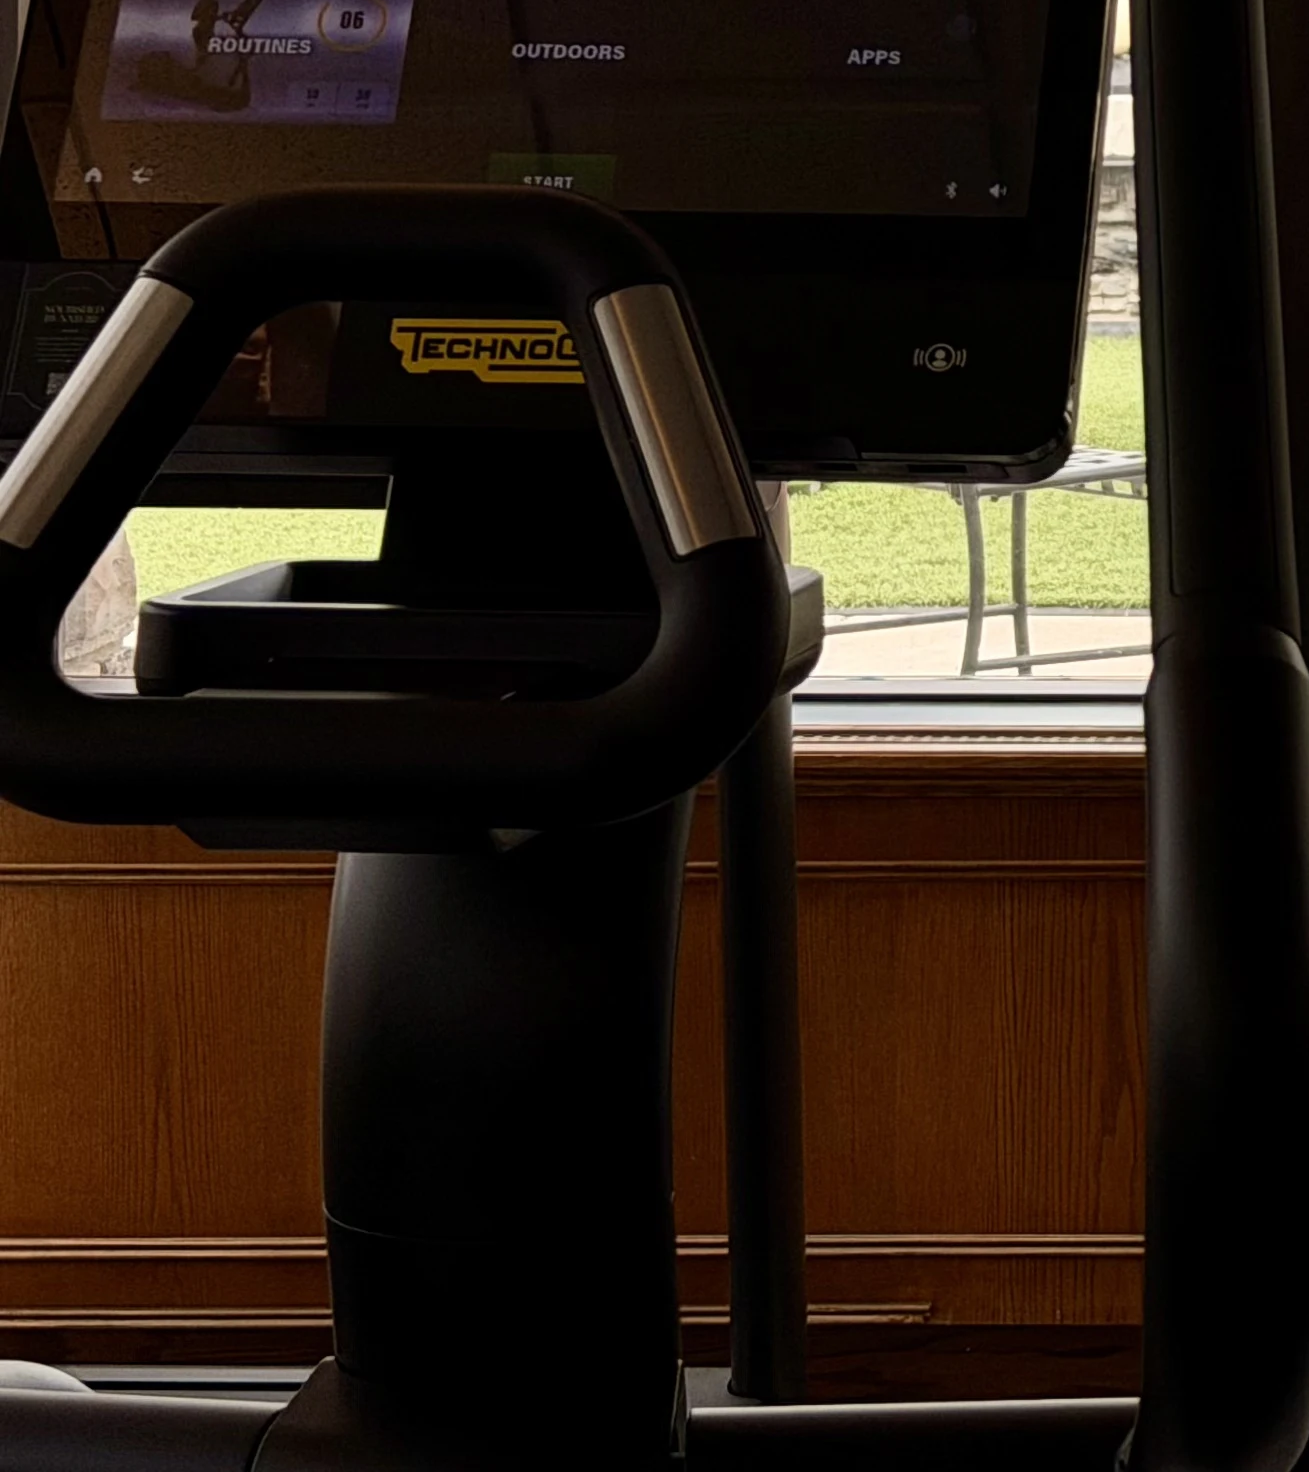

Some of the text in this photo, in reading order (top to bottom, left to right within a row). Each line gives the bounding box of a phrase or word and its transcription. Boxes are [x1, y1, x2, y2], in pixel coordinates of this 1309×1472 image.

[340, 11, 364, 29] 06
[207, 37, 313, 54] ROUTINES
[511, 43, 626, 60] OUTDOORS
[847, 48, 902, 65] APPS
[523, 175, 575, 189] START
[397, 326, 579, 371] TECHNOG
